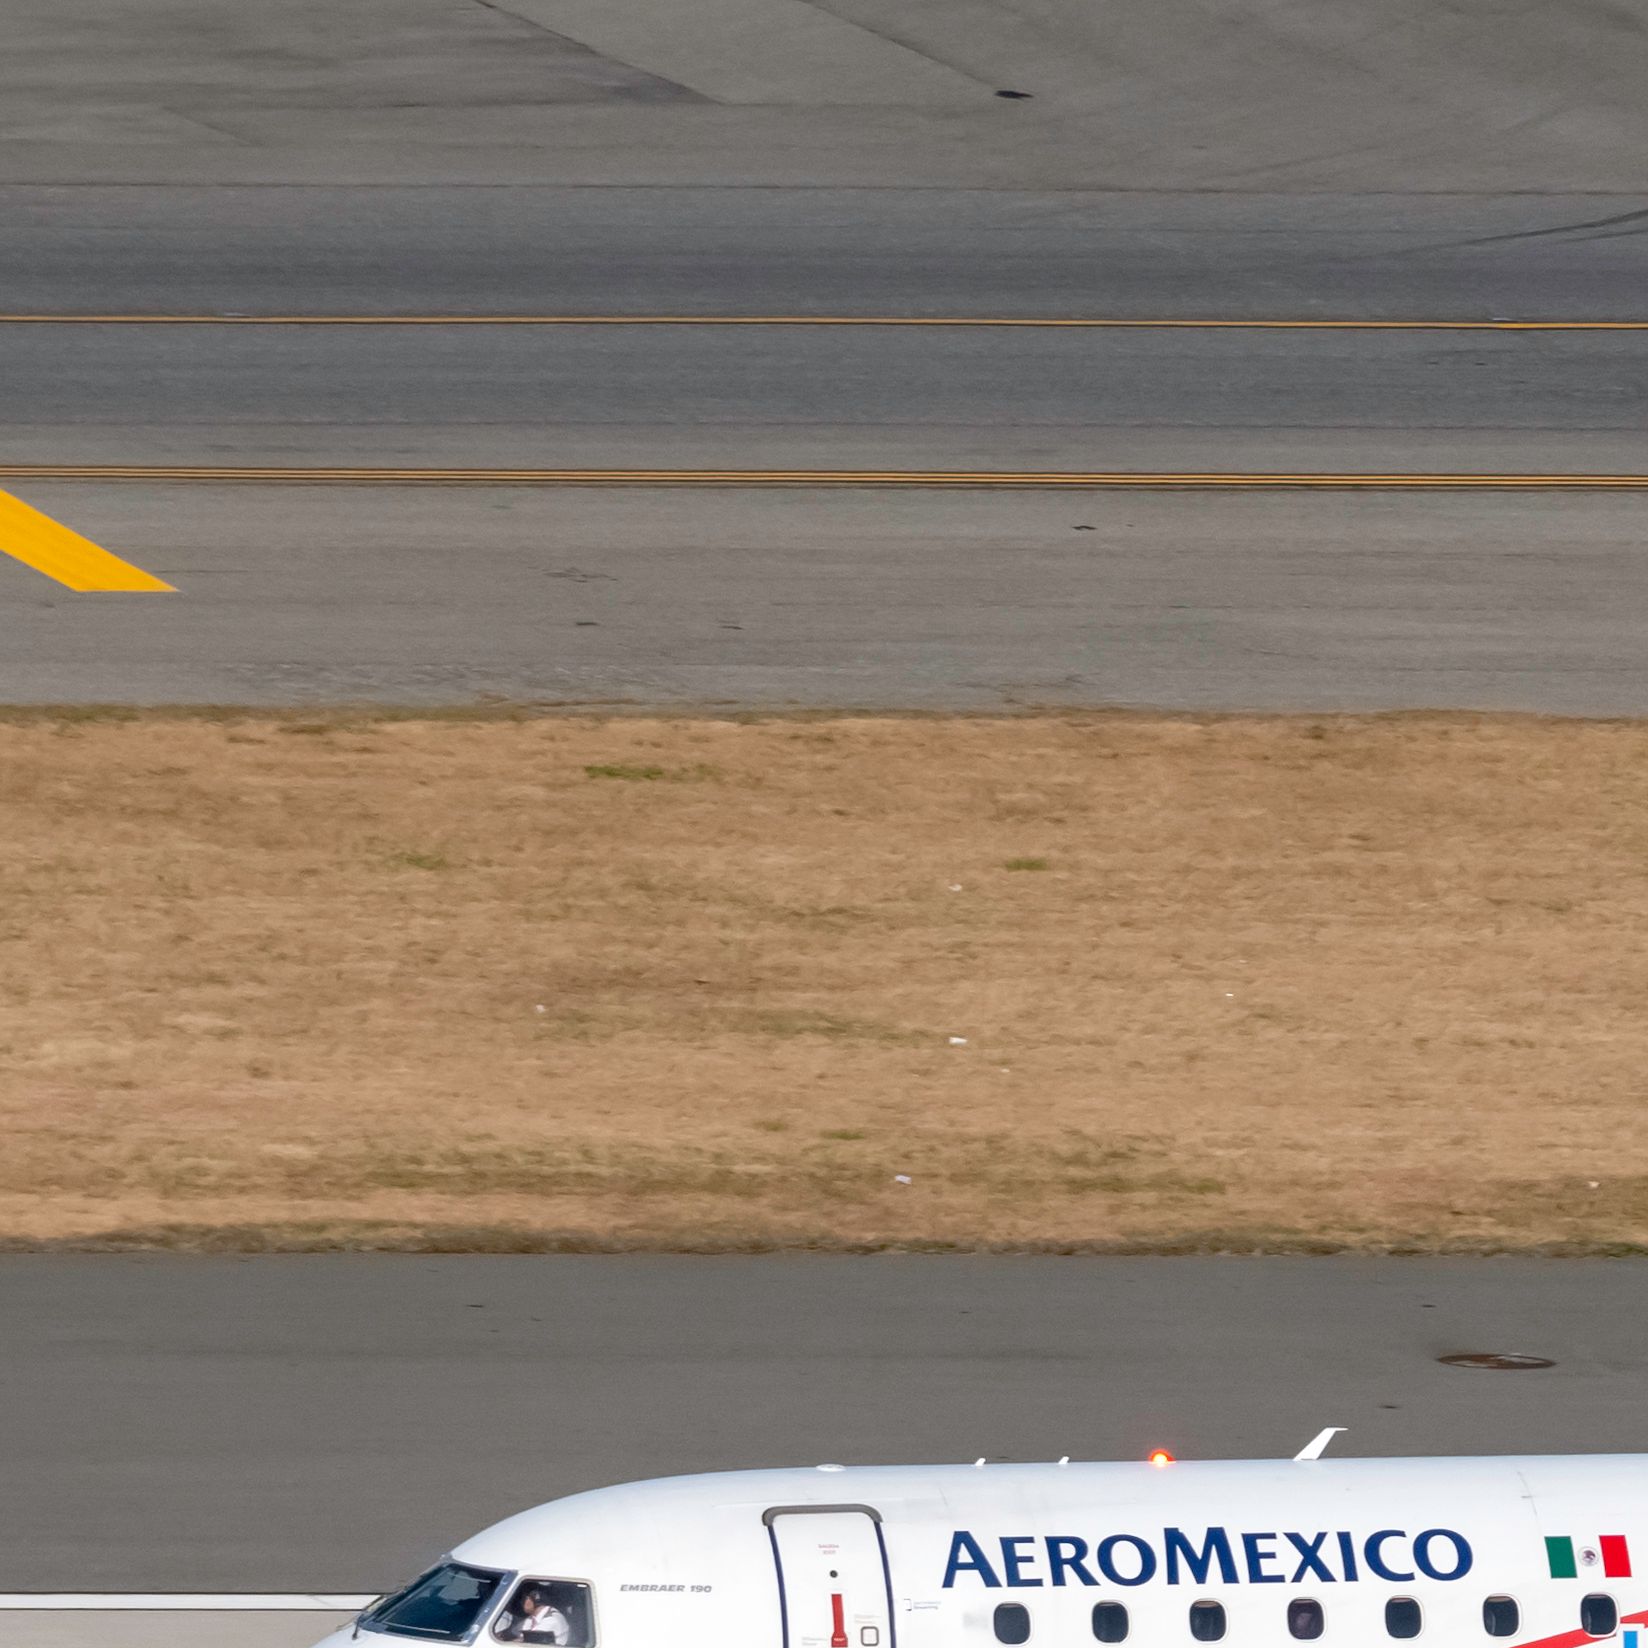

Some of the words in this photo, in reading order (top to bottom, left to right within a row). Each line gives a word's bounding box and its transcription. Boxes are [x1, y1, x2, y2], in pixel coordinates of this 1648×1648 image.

[942, 1527, 1473, 1588] AEROMEXICO
[619, 1584, 686, 1593] EMBRAER
[690, 1585, 713, 1593] 190
